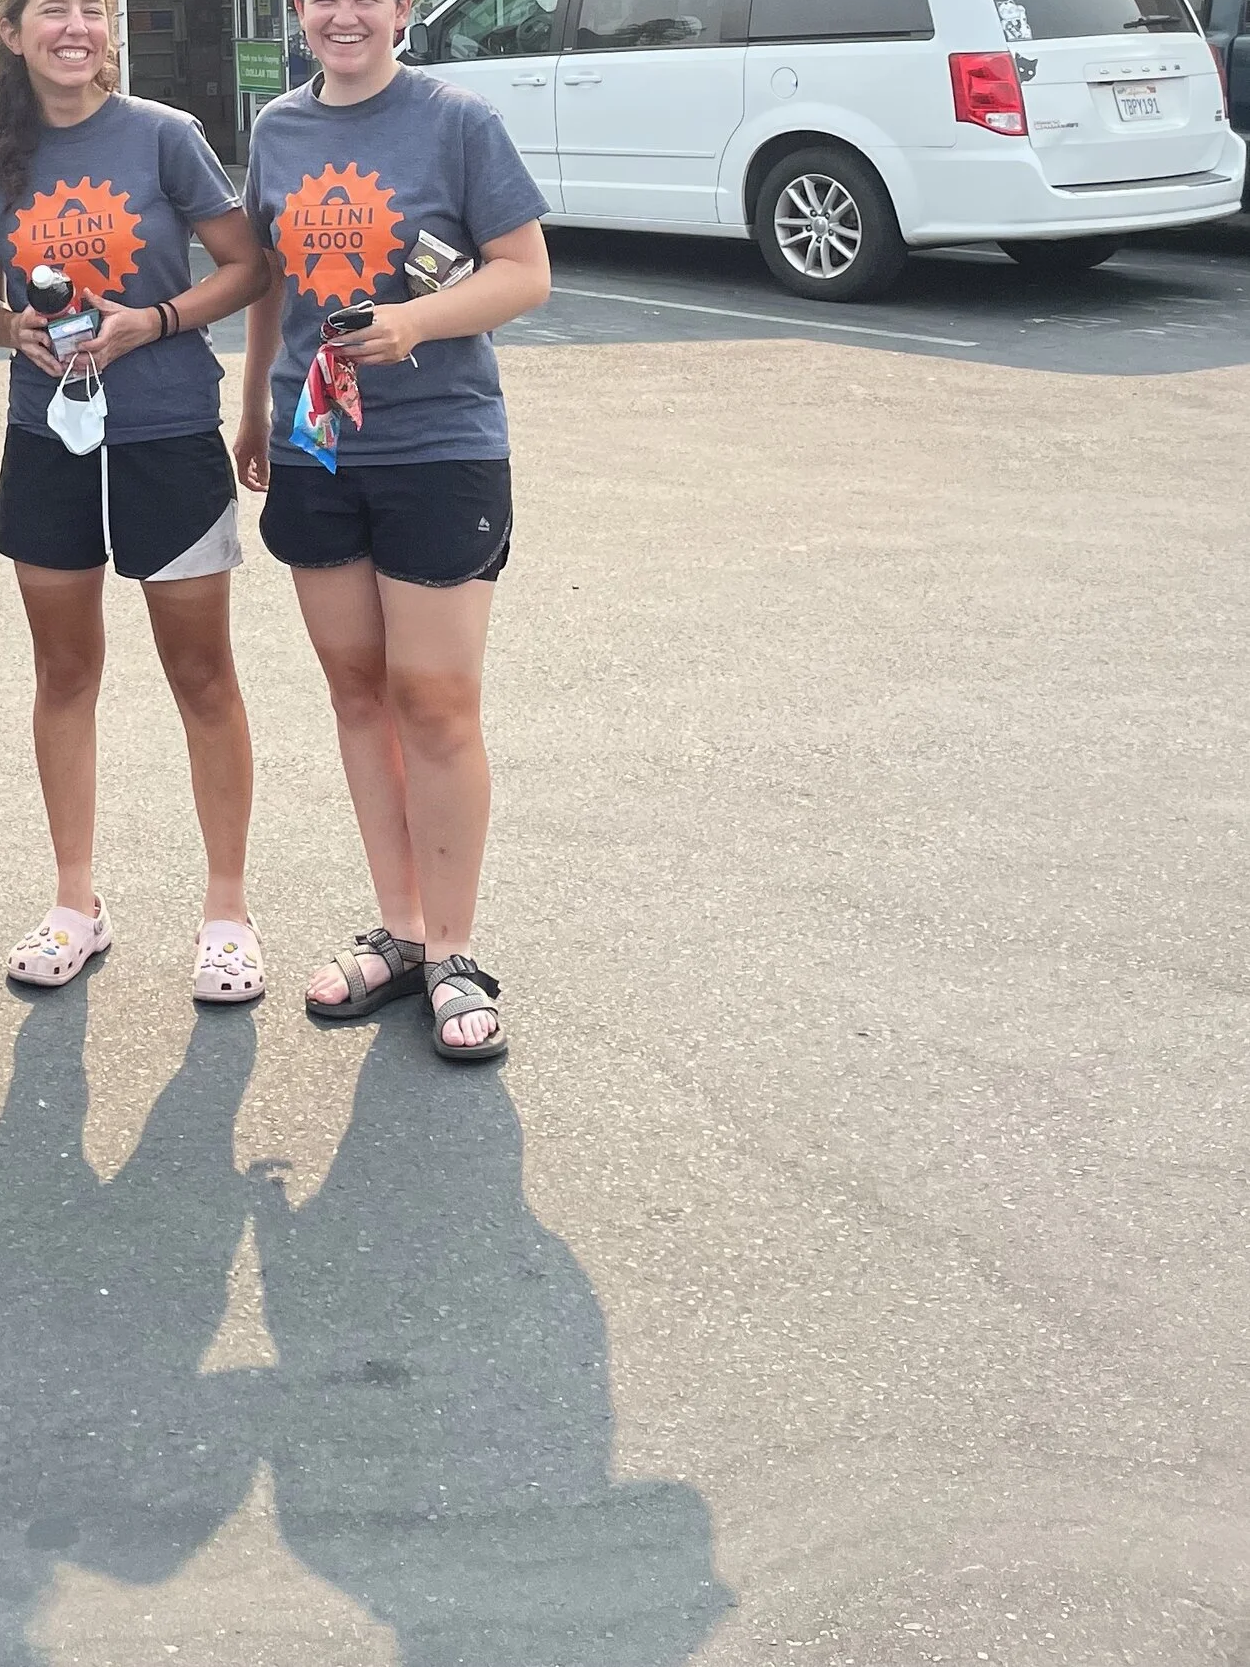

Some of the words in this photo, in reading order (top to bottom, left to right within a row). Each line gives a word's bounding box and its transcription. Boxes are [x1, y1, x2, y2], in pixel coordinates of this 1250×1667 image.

[1121, 98, 1161, 115] 7BPY191
[294, 207, 373, 226] ILLINI
[32, 213, 113, 241] ILLINI
[44, 238, 106, 260] 4000
[303, 232, 363, 250] 4000
